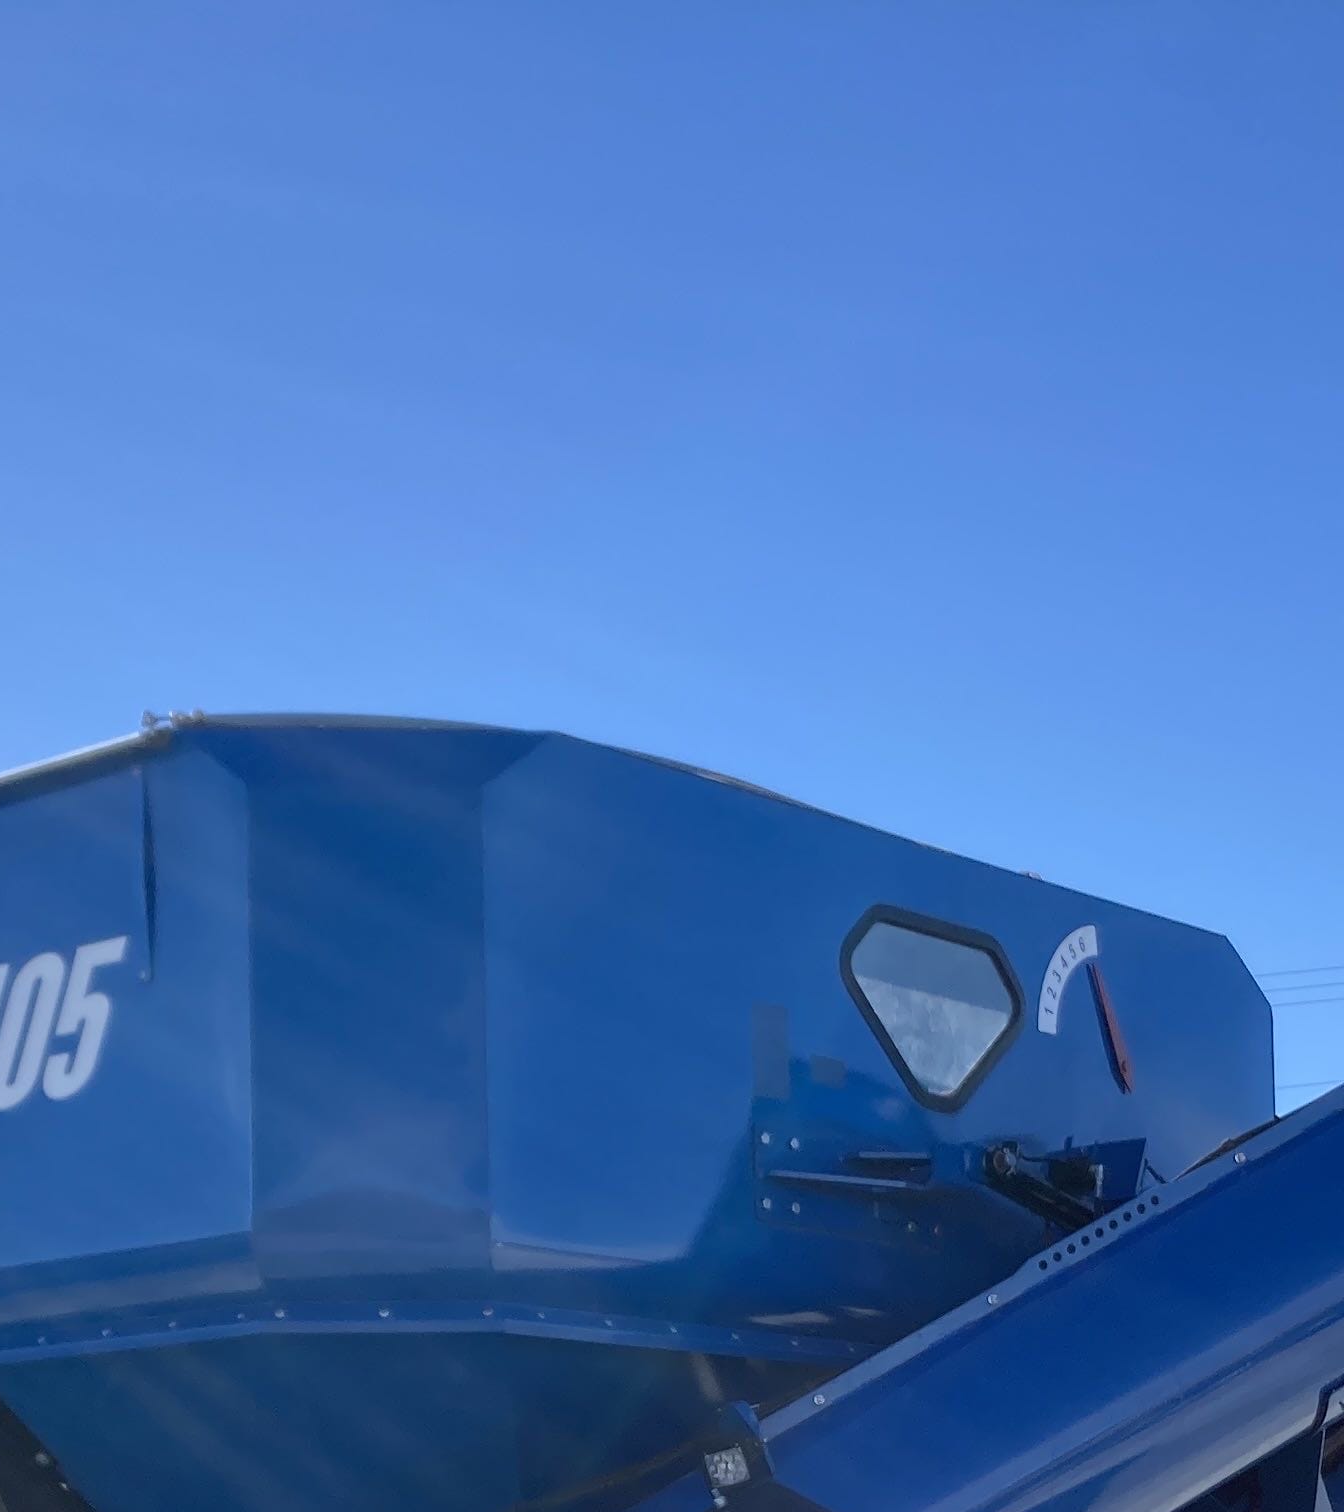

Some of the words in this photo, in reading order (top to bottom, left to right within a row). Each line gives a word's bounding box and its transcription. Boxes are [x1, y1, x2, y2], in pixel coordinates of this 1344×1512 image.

[1068, 943, 1077, 960] 5
[1078, 936, 1086, 953] 6
[1052, 969, 1062, 983] 3
[1046, 986, 1057, 1001] 2
[1044, 1006, 1055, 1016] 1
